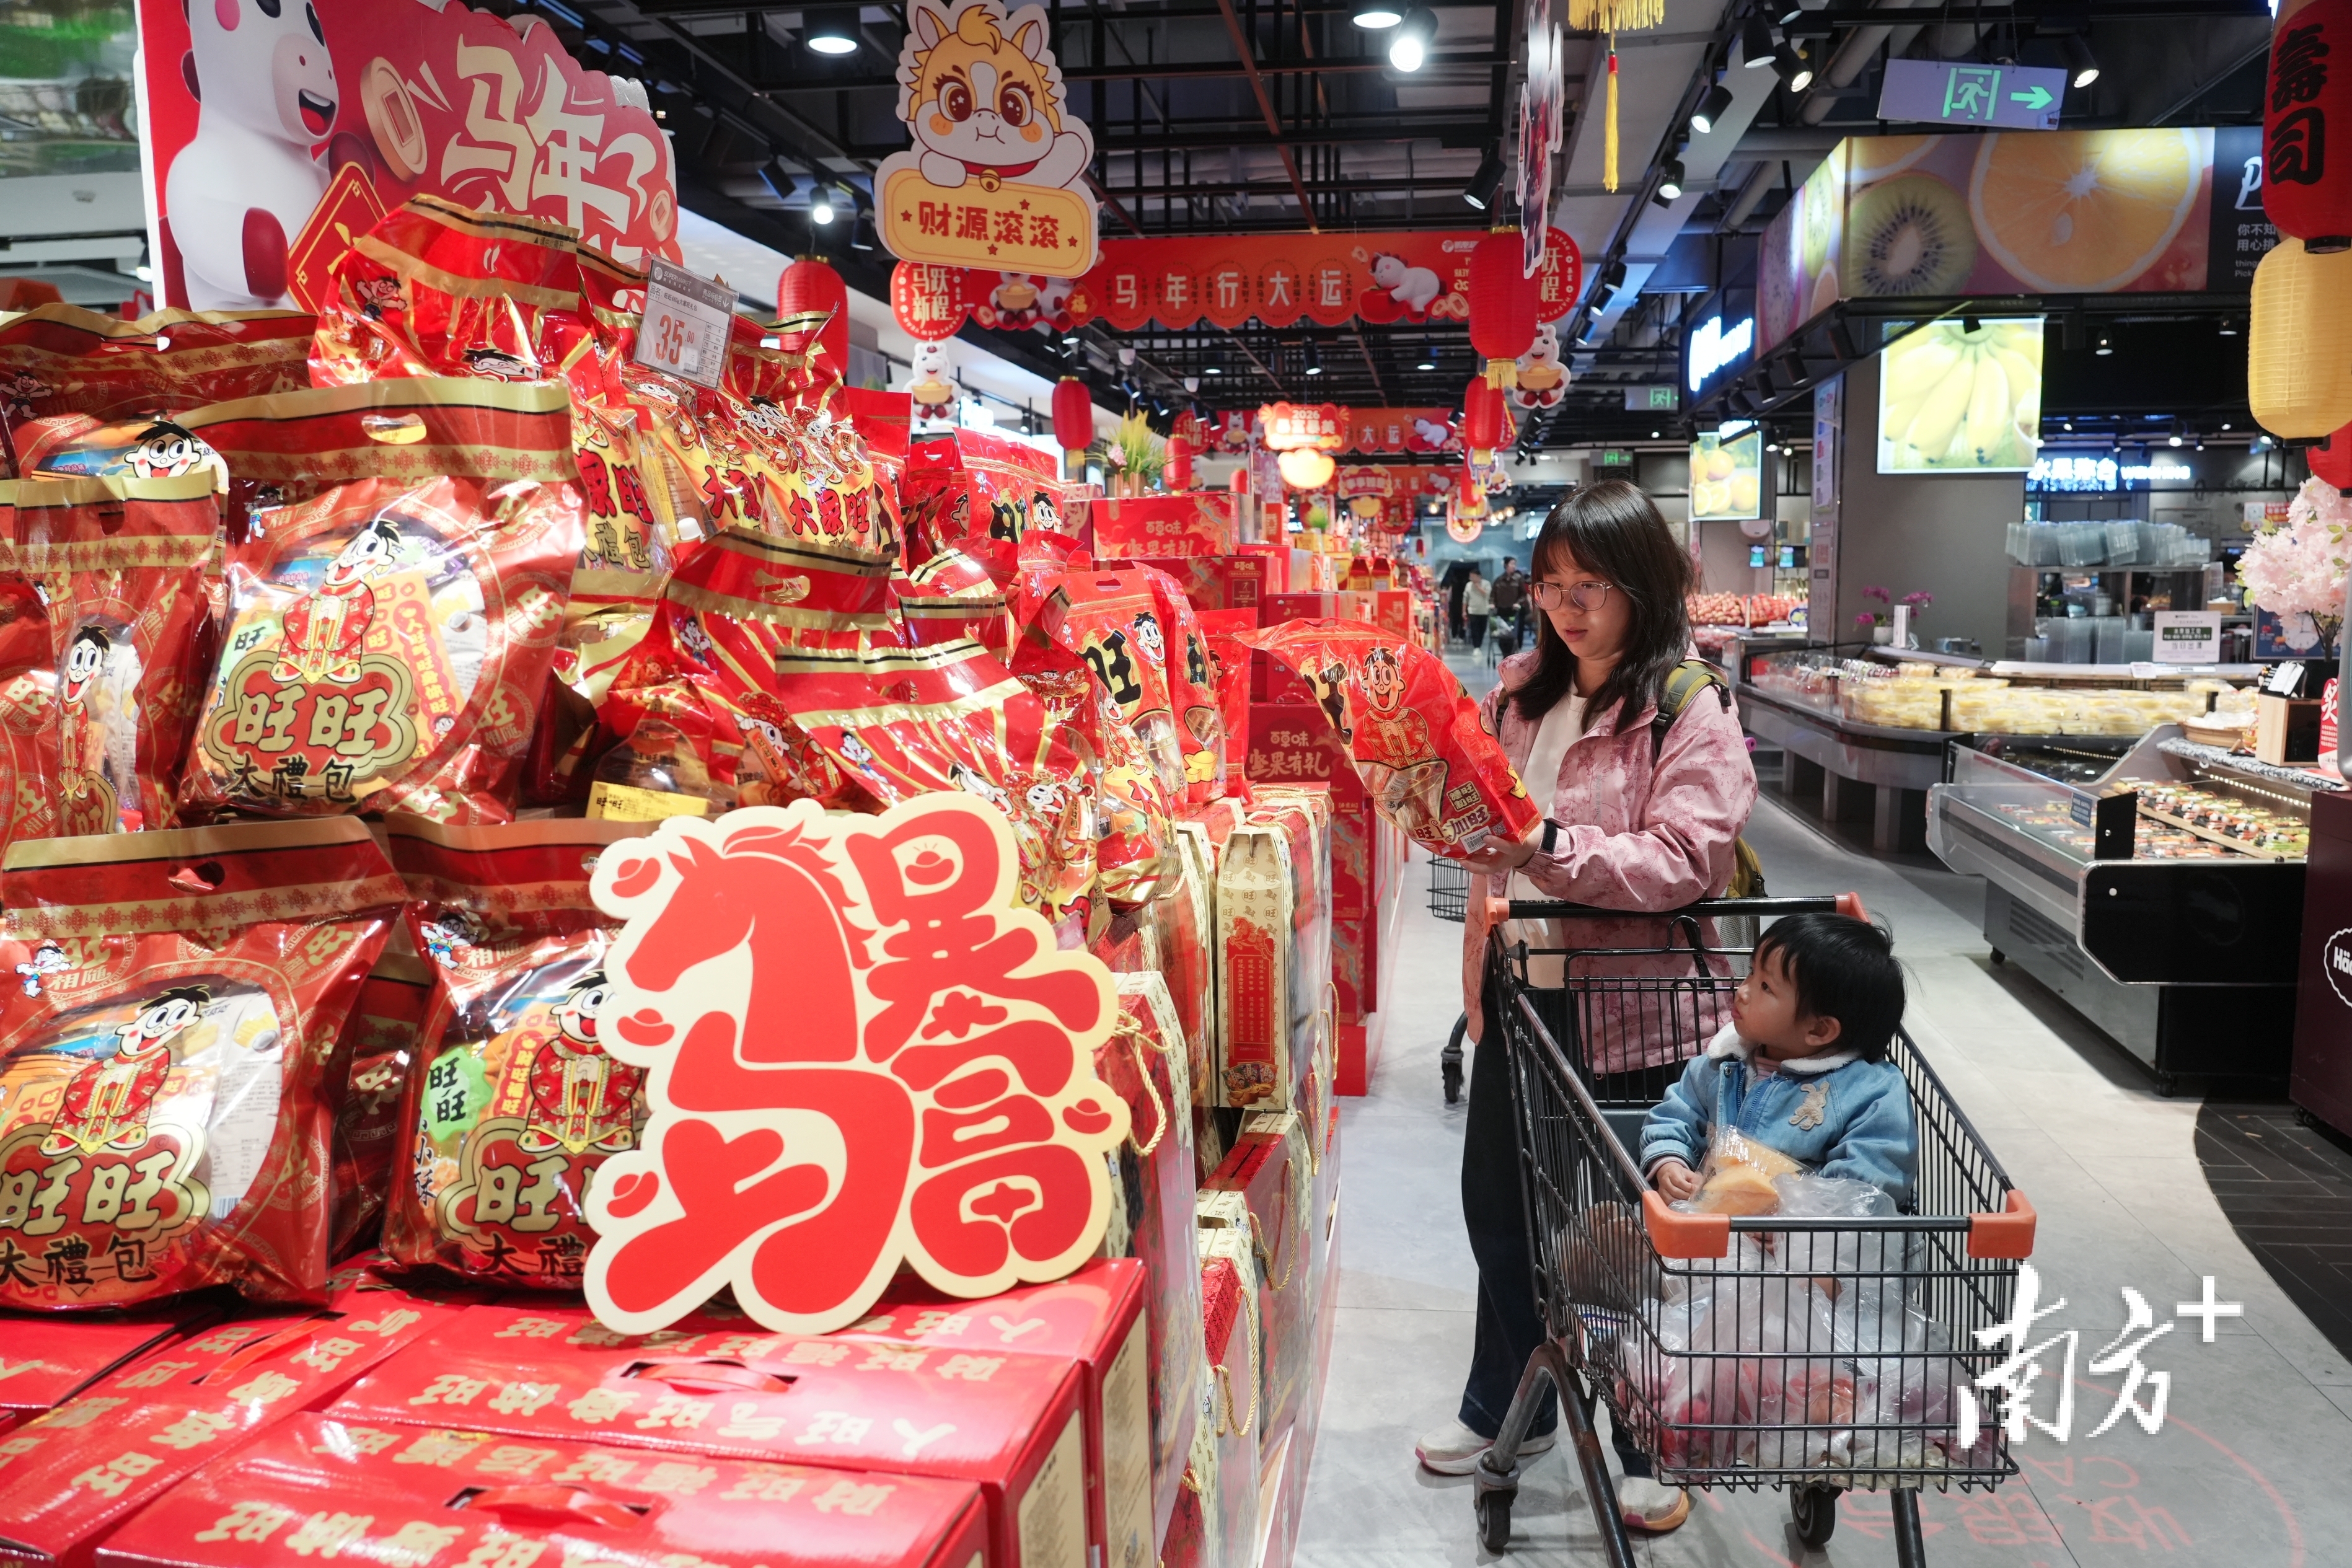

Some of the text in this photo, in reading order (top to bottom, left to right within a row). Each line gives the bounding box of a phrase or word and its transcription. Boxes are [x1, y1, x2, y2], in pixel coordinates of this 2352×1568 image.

[917, 200, 1061, 250] 财源滚滚
[2235, 259, 2259, 268] thing
[664, 270, 692, 288] SUPERMARKET
[1116, 270, 1342, 309] 马年行大运
[1541, 276, 1564, 302] 程
[1070, 293, 1088, 313] 福
[1292, 410, 1320, 420] 2026
[1146, 520, 1182, 536] 百草味
[1235, 562, 1255, 570] 百草味
[376, 586, 394, 601] 旺
[368, 631, 388, 648] 旺
[236, 684, 389, 755] 旺旺
[1271, 731, 1309, 747] 百草味
[1249, 750, 1330, 778] 坚果有礼
[227, 754, 358, 805] 大禮包
[1245, 857, 1256, 865] 旺
[1223, 873, 1234, 882] 旺
[1265, 873, 1277, 883] 旺
[1243, 891, 1254, 899] 旺
[1222, 908, 1233, 917] 旺
[1265, 909, 1276, 918] 旺
[430, 1057, 467, 1123] 旺旺
[501, 1050, 534, 1116] 财旺福旺
[0, 1149, 177, 1236] 旺旺
[0, 1236, 148, 1288] 大禮包
